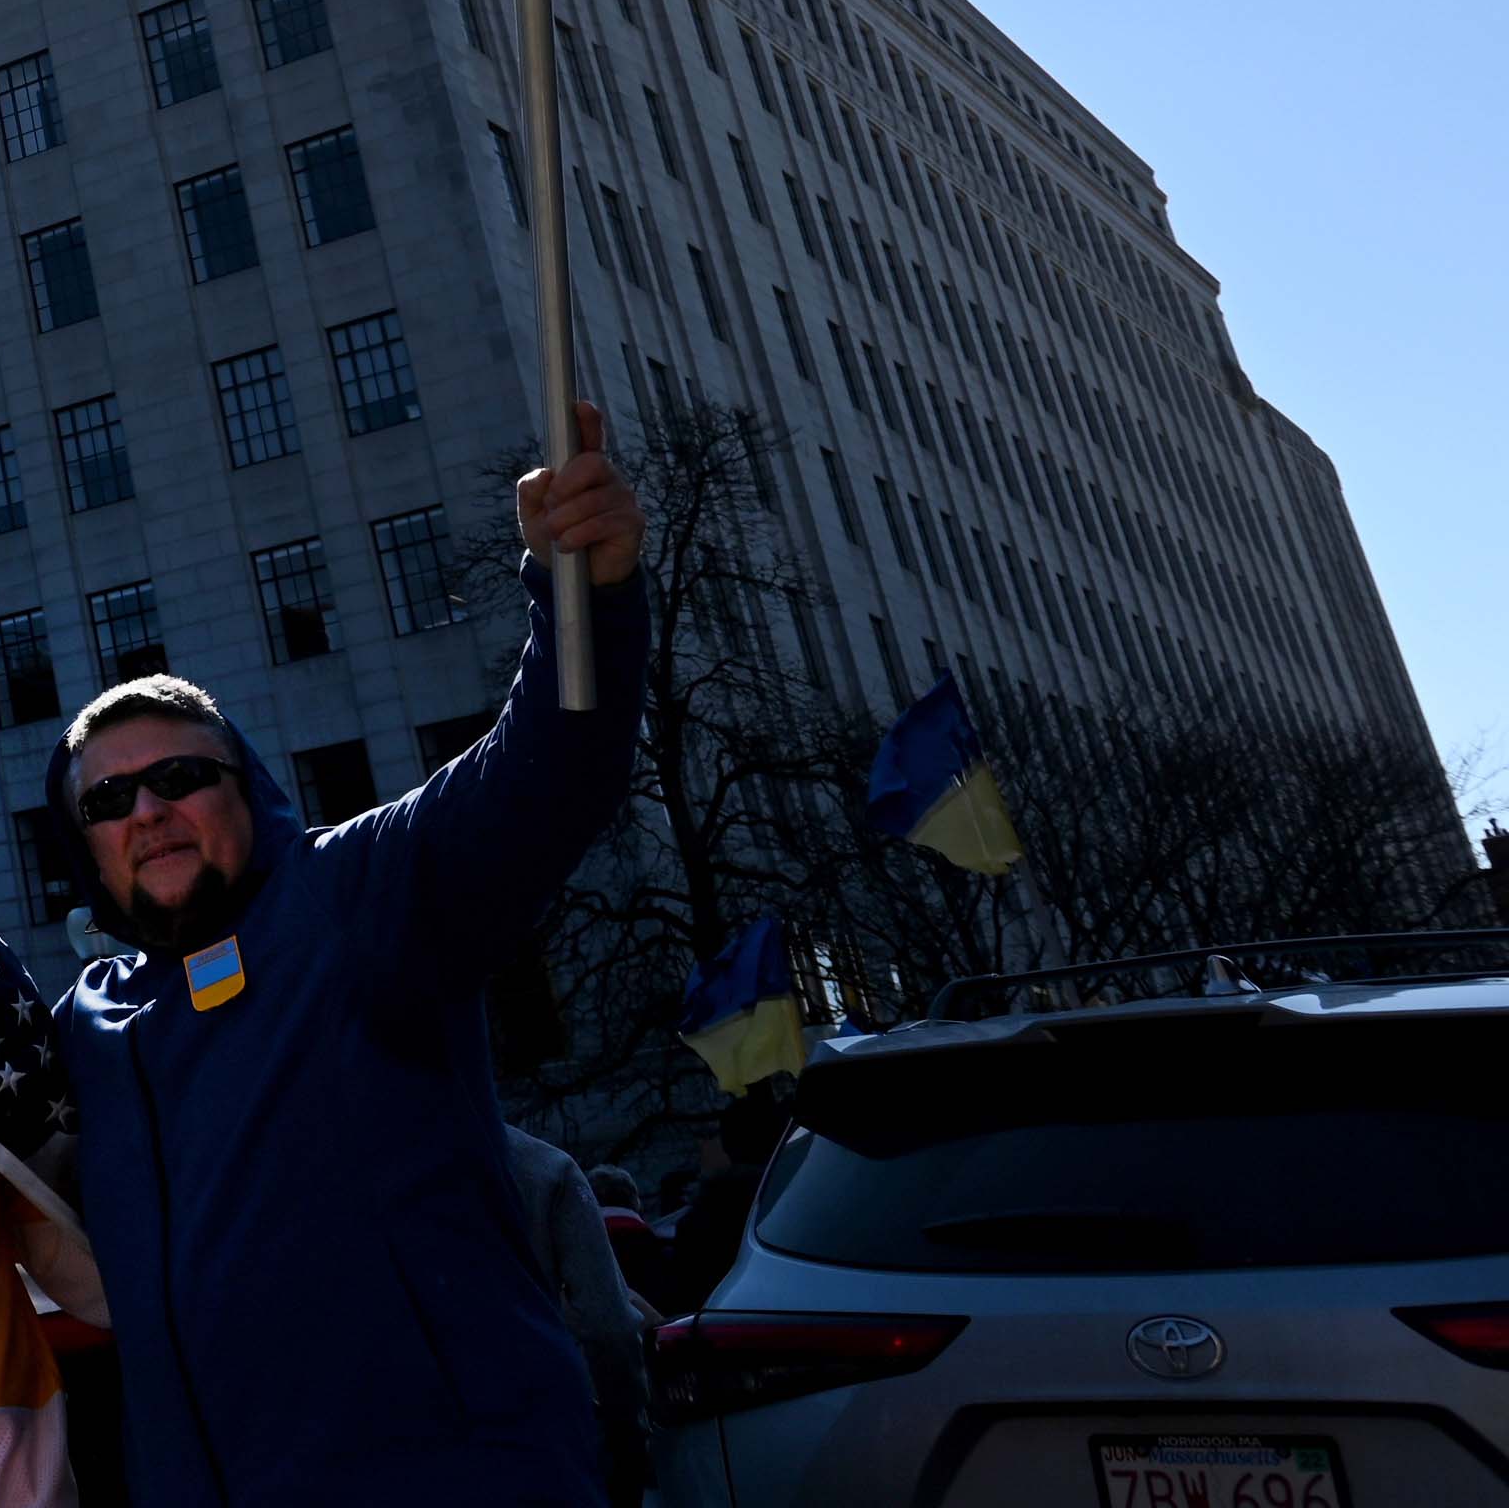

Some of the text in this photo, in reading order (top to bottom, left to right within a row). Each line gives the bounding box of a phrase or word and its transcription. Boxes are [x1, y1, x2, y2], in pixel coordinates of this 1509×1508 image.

[1238, 1437, 1262, 1447] MA
[1104, 1446, 1138, 1462] JUN
[1149, 1447, 1281, 1466] Massachusetts
[1299, 1451, 1326, 1468] 22
[1234, 1472, 1333, 1508] 696
